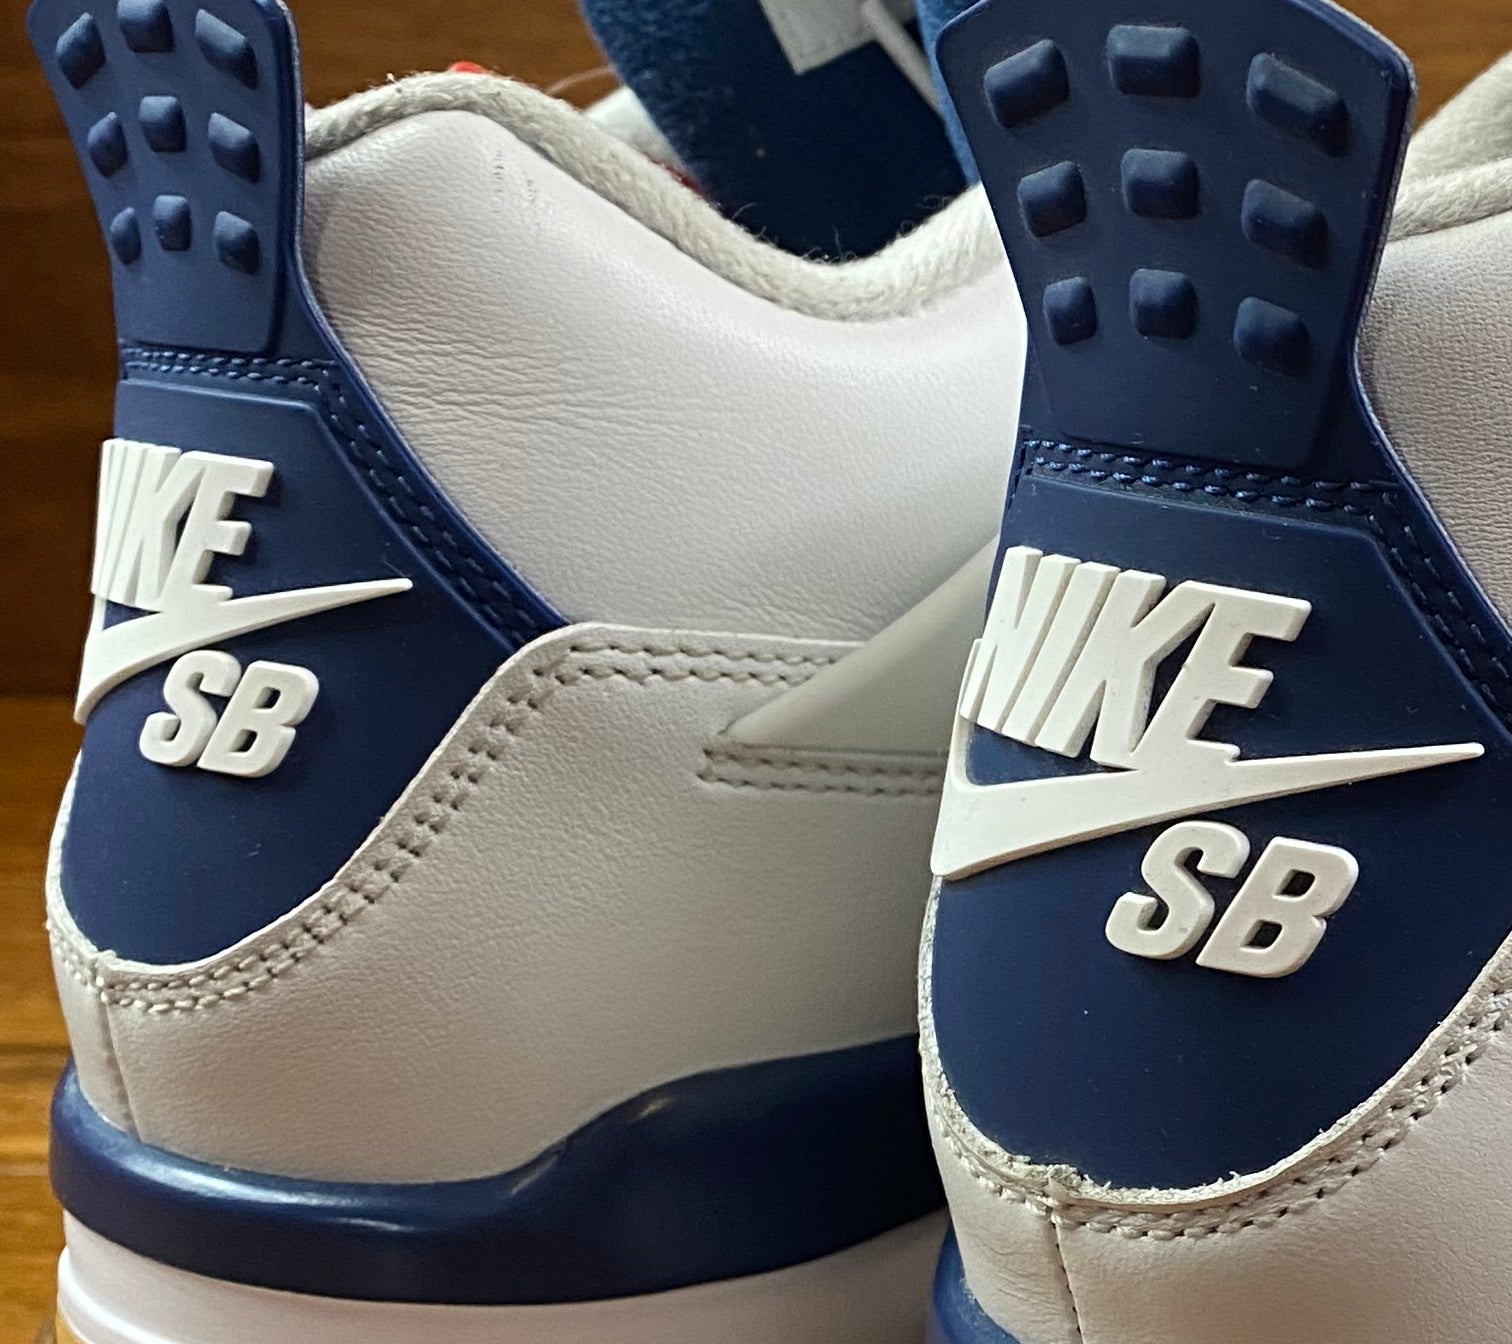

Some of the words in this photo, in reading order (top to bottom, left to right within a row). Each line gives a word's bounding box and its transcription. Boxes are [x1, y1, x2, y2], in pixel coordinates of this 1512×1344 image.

[138, 648, 320, 778] SB
[959, 545, 1312, 772] NIKE
[1104, 820, 1360, 979] SB
